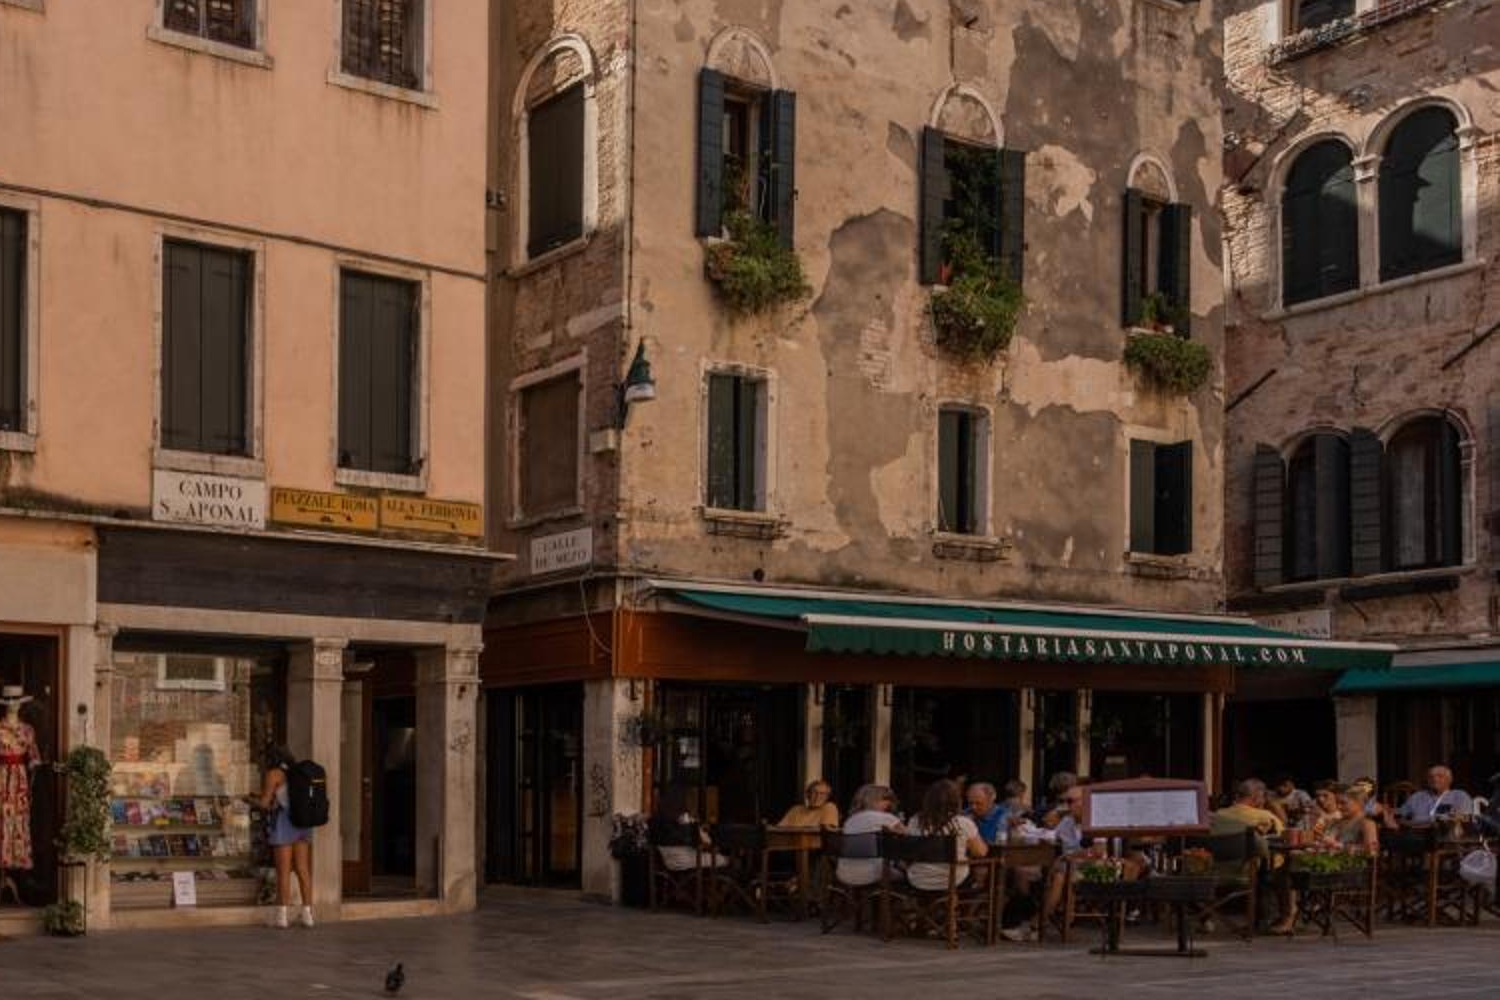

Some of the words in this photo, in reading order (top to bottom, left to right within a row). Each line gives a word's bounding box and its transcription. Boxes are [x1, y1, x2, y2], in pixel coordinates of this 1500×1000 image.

[179, 479, 242, 500] CAMPO
[186, 502, 259, 523] APONAL
[275, 491, 338, 508] PIAZZALE
[341, 497, 374, 513] ROMA
[385, 498, 415, 513] ALLA
[420, 503, 478, 520] FERROVIA
[942, 631, 1306, 664] HOSTARIASANTAPONAL.COM
